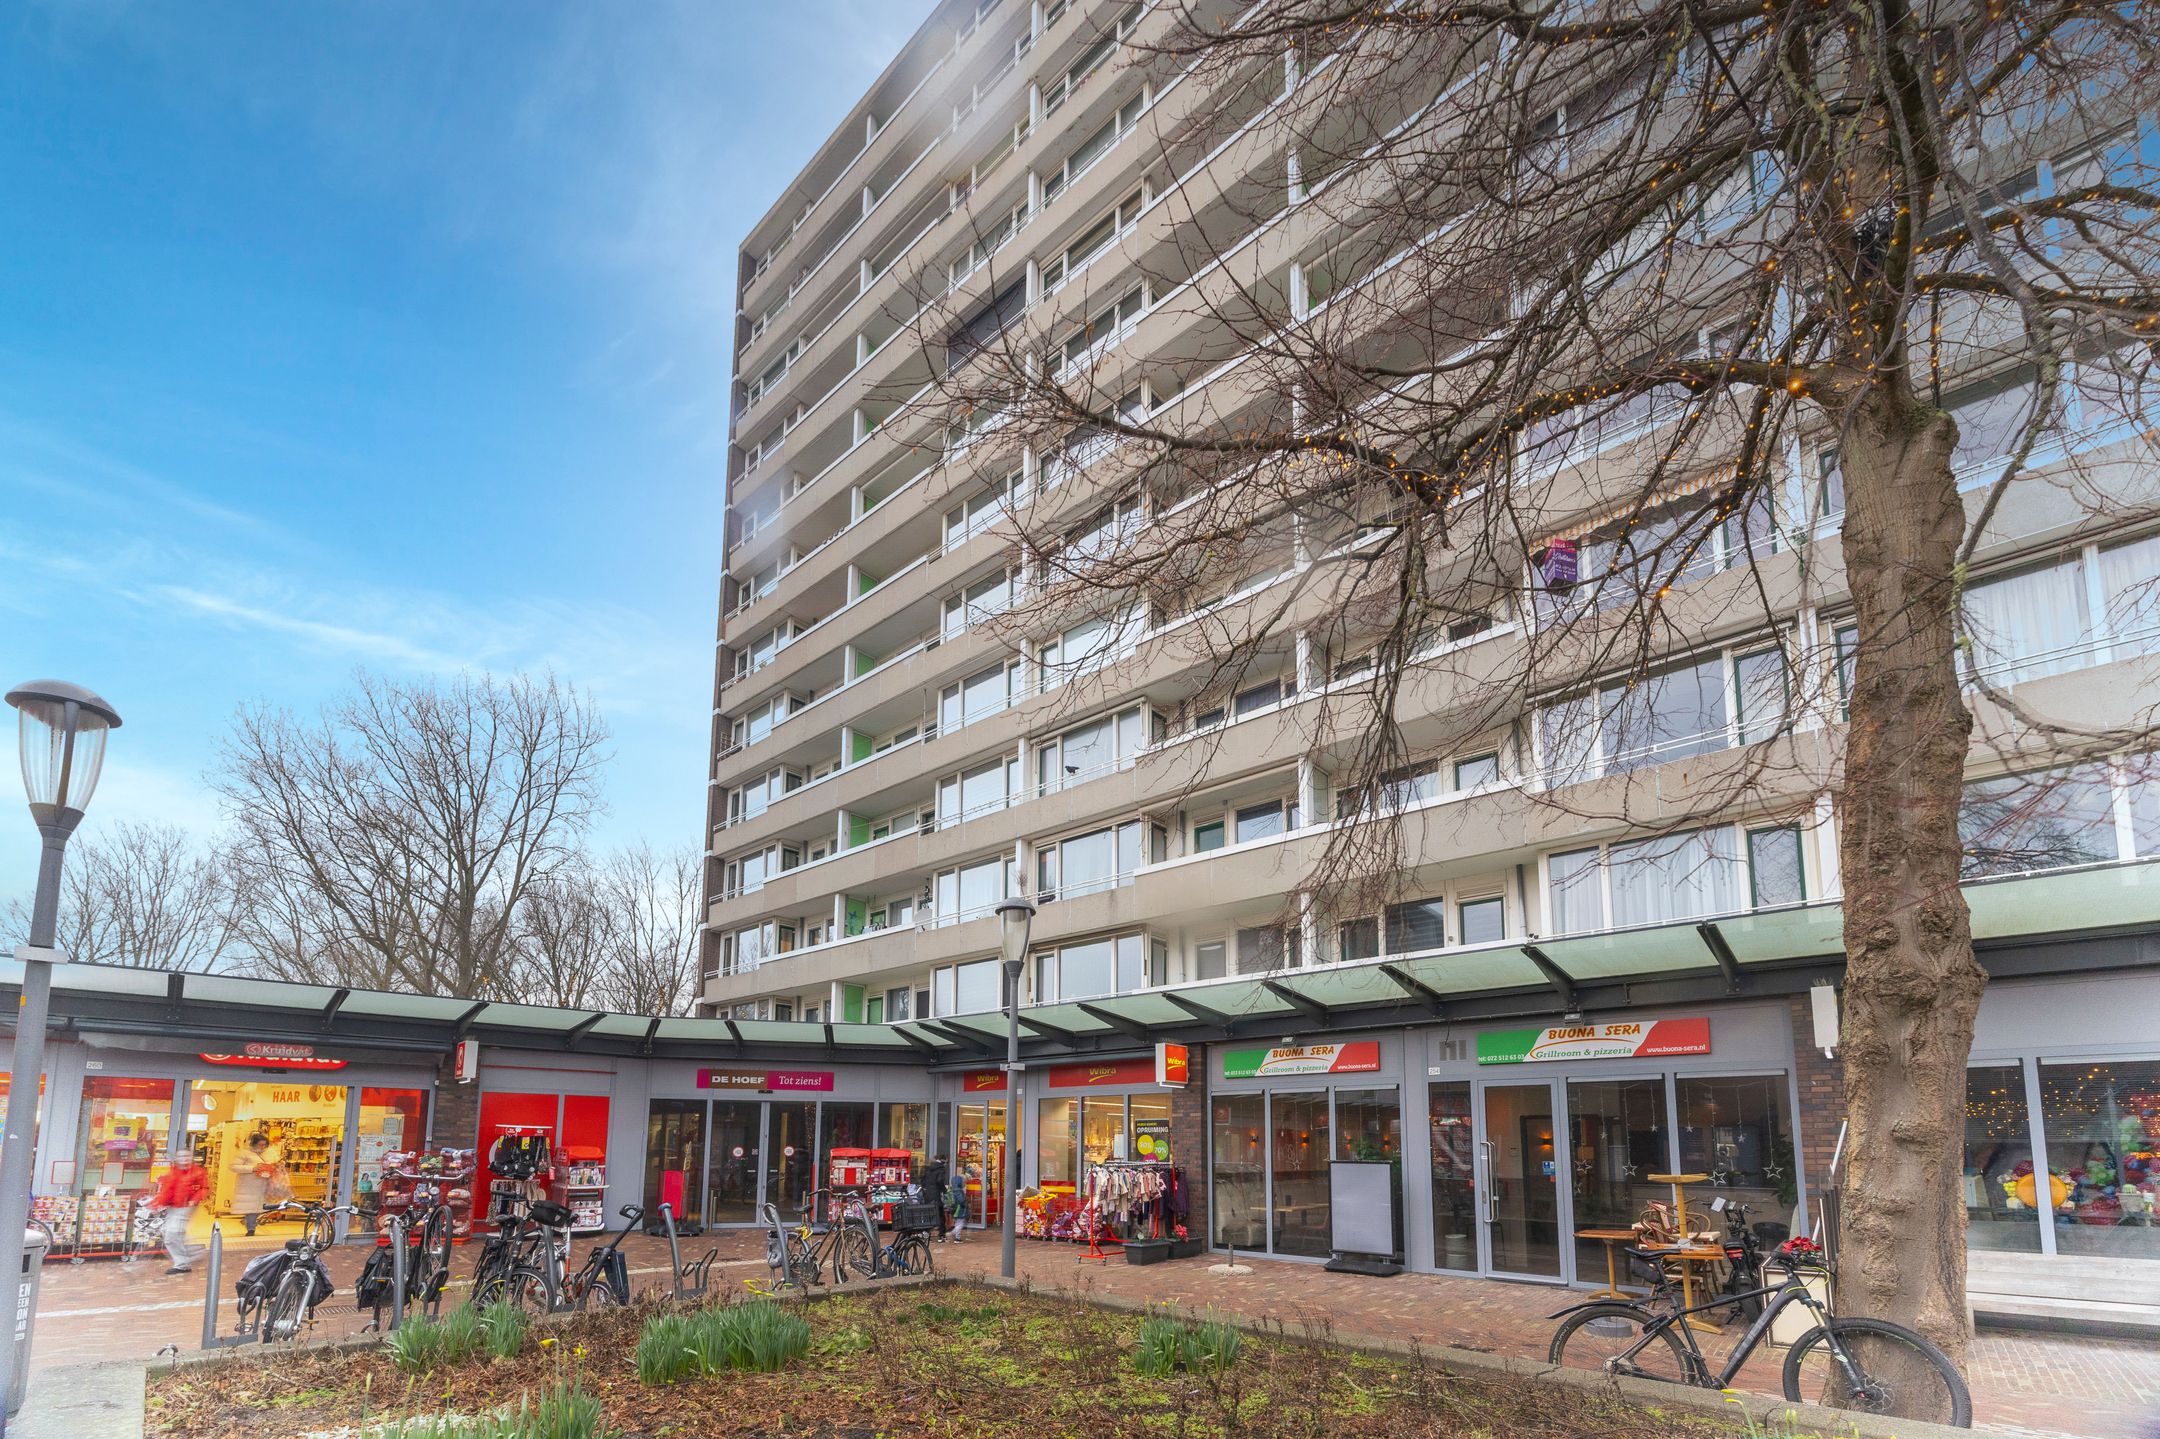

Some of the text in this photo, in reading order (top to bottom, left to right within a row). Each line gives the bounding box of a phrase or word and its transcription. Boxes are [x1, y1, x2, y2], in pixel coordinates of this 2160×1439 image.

[1548, 1024, 1641, 1039] BUONA SERA
[262, 1044, 310, 1056] Kruidvat
[1272, 1046, 1335, 1058] BUONA SERA
[1535, 1049, 1582, 1059] Grillroom
[1594, 1047, 1632, 1056] pizzeria
[1647, 1044, 1706, 1053] www.buona-sera.nl
[1167, 1056, 1186, 1066] Wibra
[1089, 1066, 1116, 1075] Wibra
[1263, 1066, 1295, 1074] Grillroom
[1302, 1065, 1329, 1073] pizzeria
[711, 1075, 765, 1084] DE HOEF
[778, 1075, 822, 1086] Tot ziens!
[977, 1074, 1000, 1082] Wibra
[272, 1090, 300, 1103] HAAR
